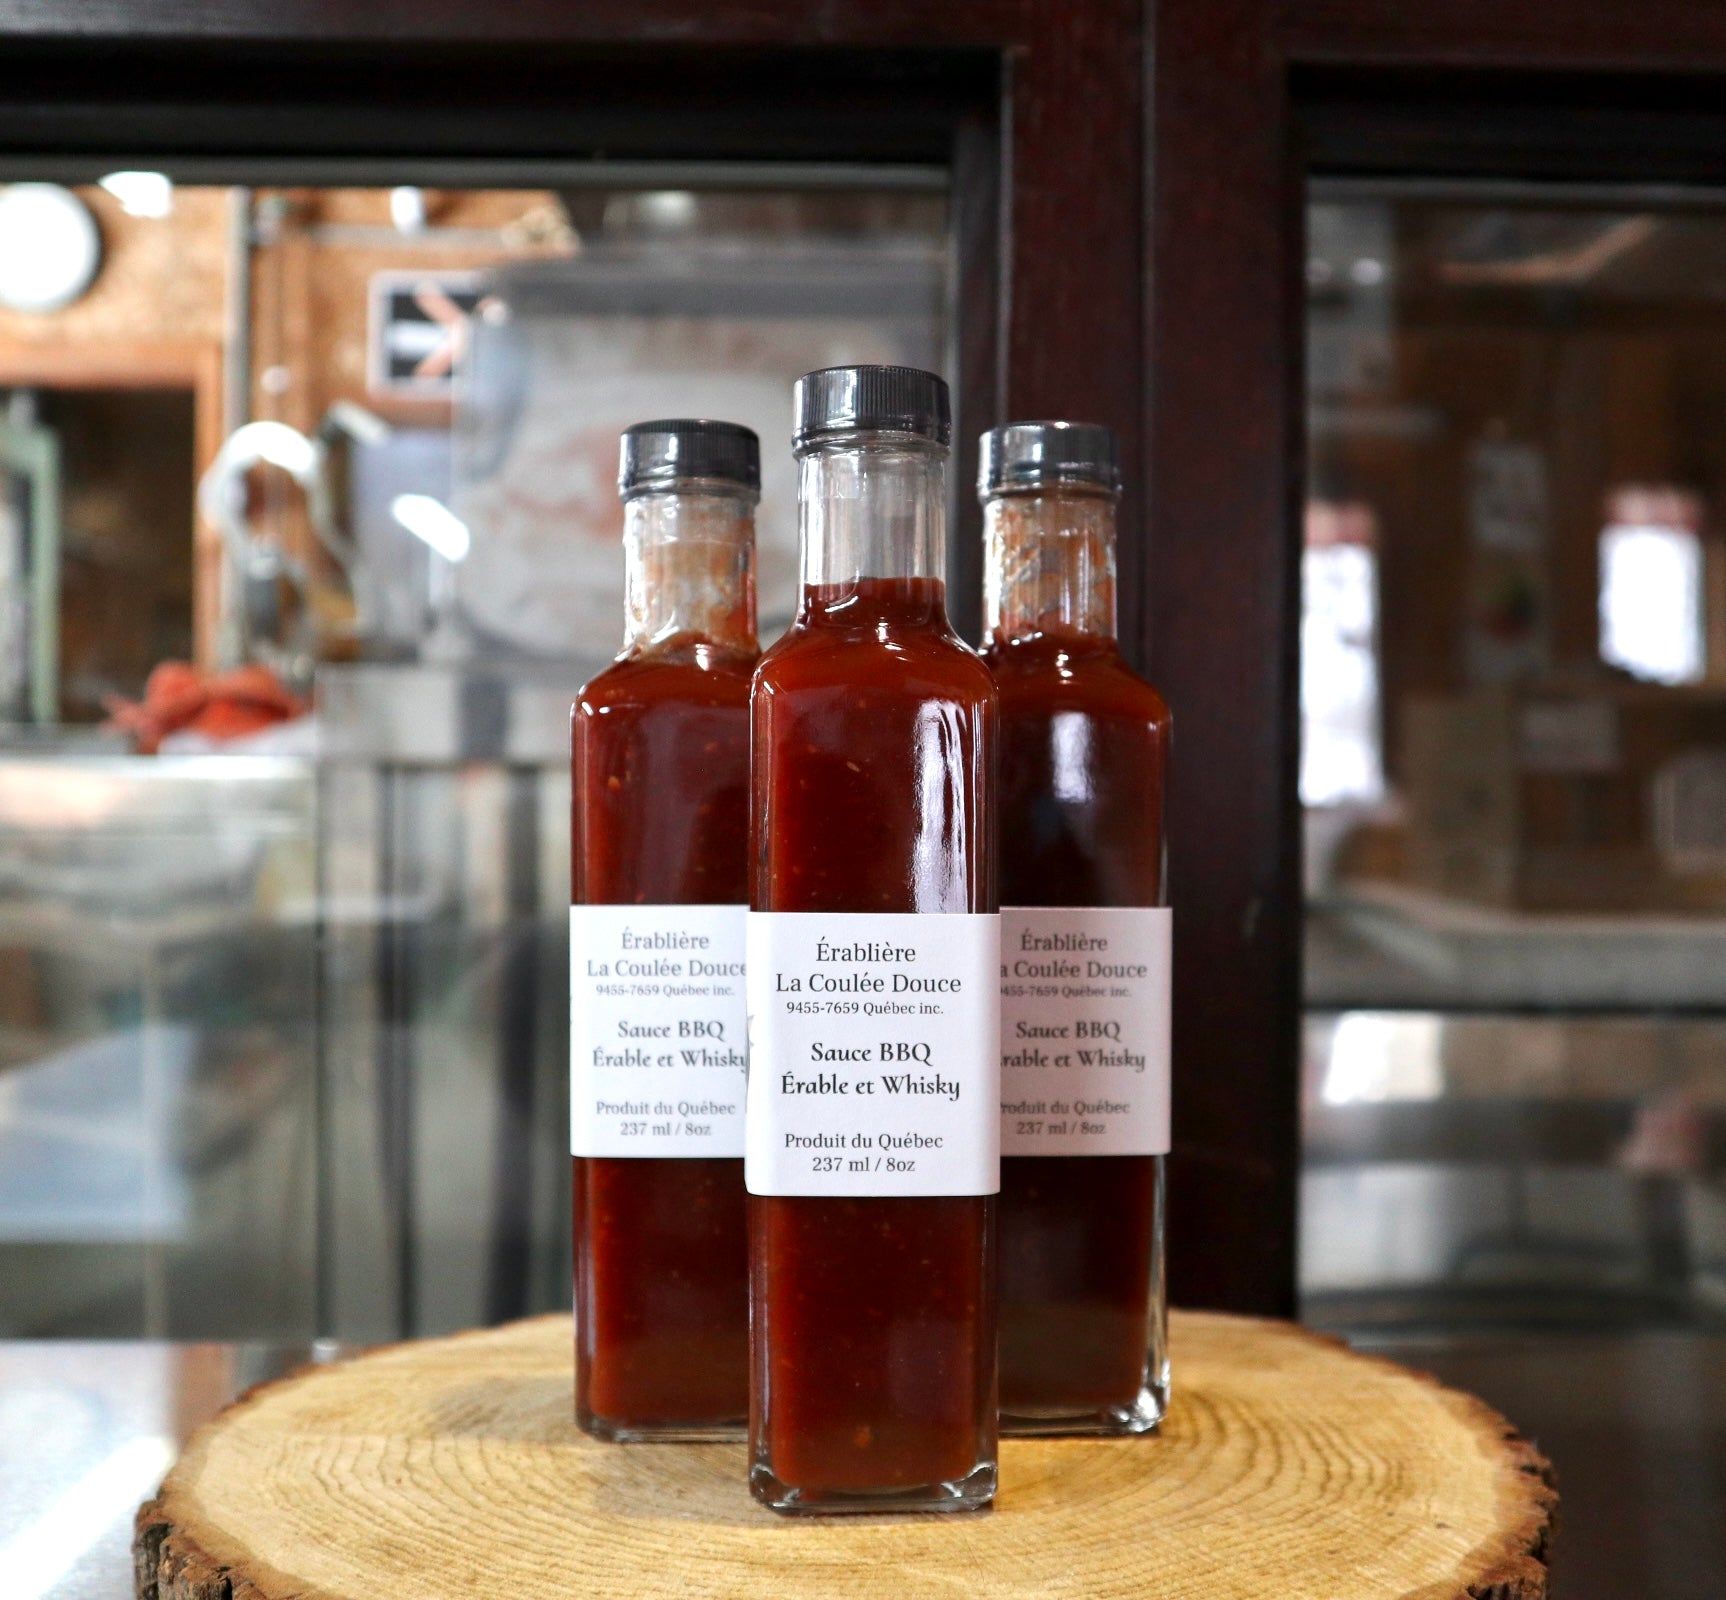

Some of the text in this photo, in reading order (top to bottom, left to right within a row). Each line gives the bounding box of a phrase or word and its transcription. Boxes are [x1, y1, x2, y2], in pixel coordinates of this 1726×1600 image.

[621, 927, 710, 950] Érablière
[1021, 929, 1108, 951] Érablière
[816, 936, 916, 962] Érablière
[587, 960, 609, 977] La
[615, 959, 682, 977] Coulée
[1014, 960, 1080, 978] Coulée
[1088, 961, 1147, 978] Douce
[596, 984, 735, 998] 9455-7659 Québec inc.
[776, 972, 962, 992] La Coulée Douce
[1062, 985, 1105, 998] Québec
[1110, 986, 1132, 997] inc.
[786, 1001, 944, 1016] 9455-7659 Québec inc.
[618, 1021, 726, 1042] Sauce BBQ
[1016, 1021, 1121, 1042] Sauce BBQ
[593, 1046, 651, 1067] Érable
[657, 1055, 673, 1067] et
[811, 1043, 934, 1067] Sauce BBQ
[1000, 1048, 1146, 1073] rable et Whisky
[781, 1071, 960, 1101] Érable et Whisky
[596, 1101, 736, 1117] Produit du Québec
[1000, 1100, 1130, 1117] roduit du Québec
[620, 1122, 711, 1136] 237 ml / 8oz
[1016, 1121, 1106, 1134] 237 ml / 8oz
[785, 1132, 943, 1151] Produit du Québec
[812, 1157, 916, 1172] 237 ml / 8oz
